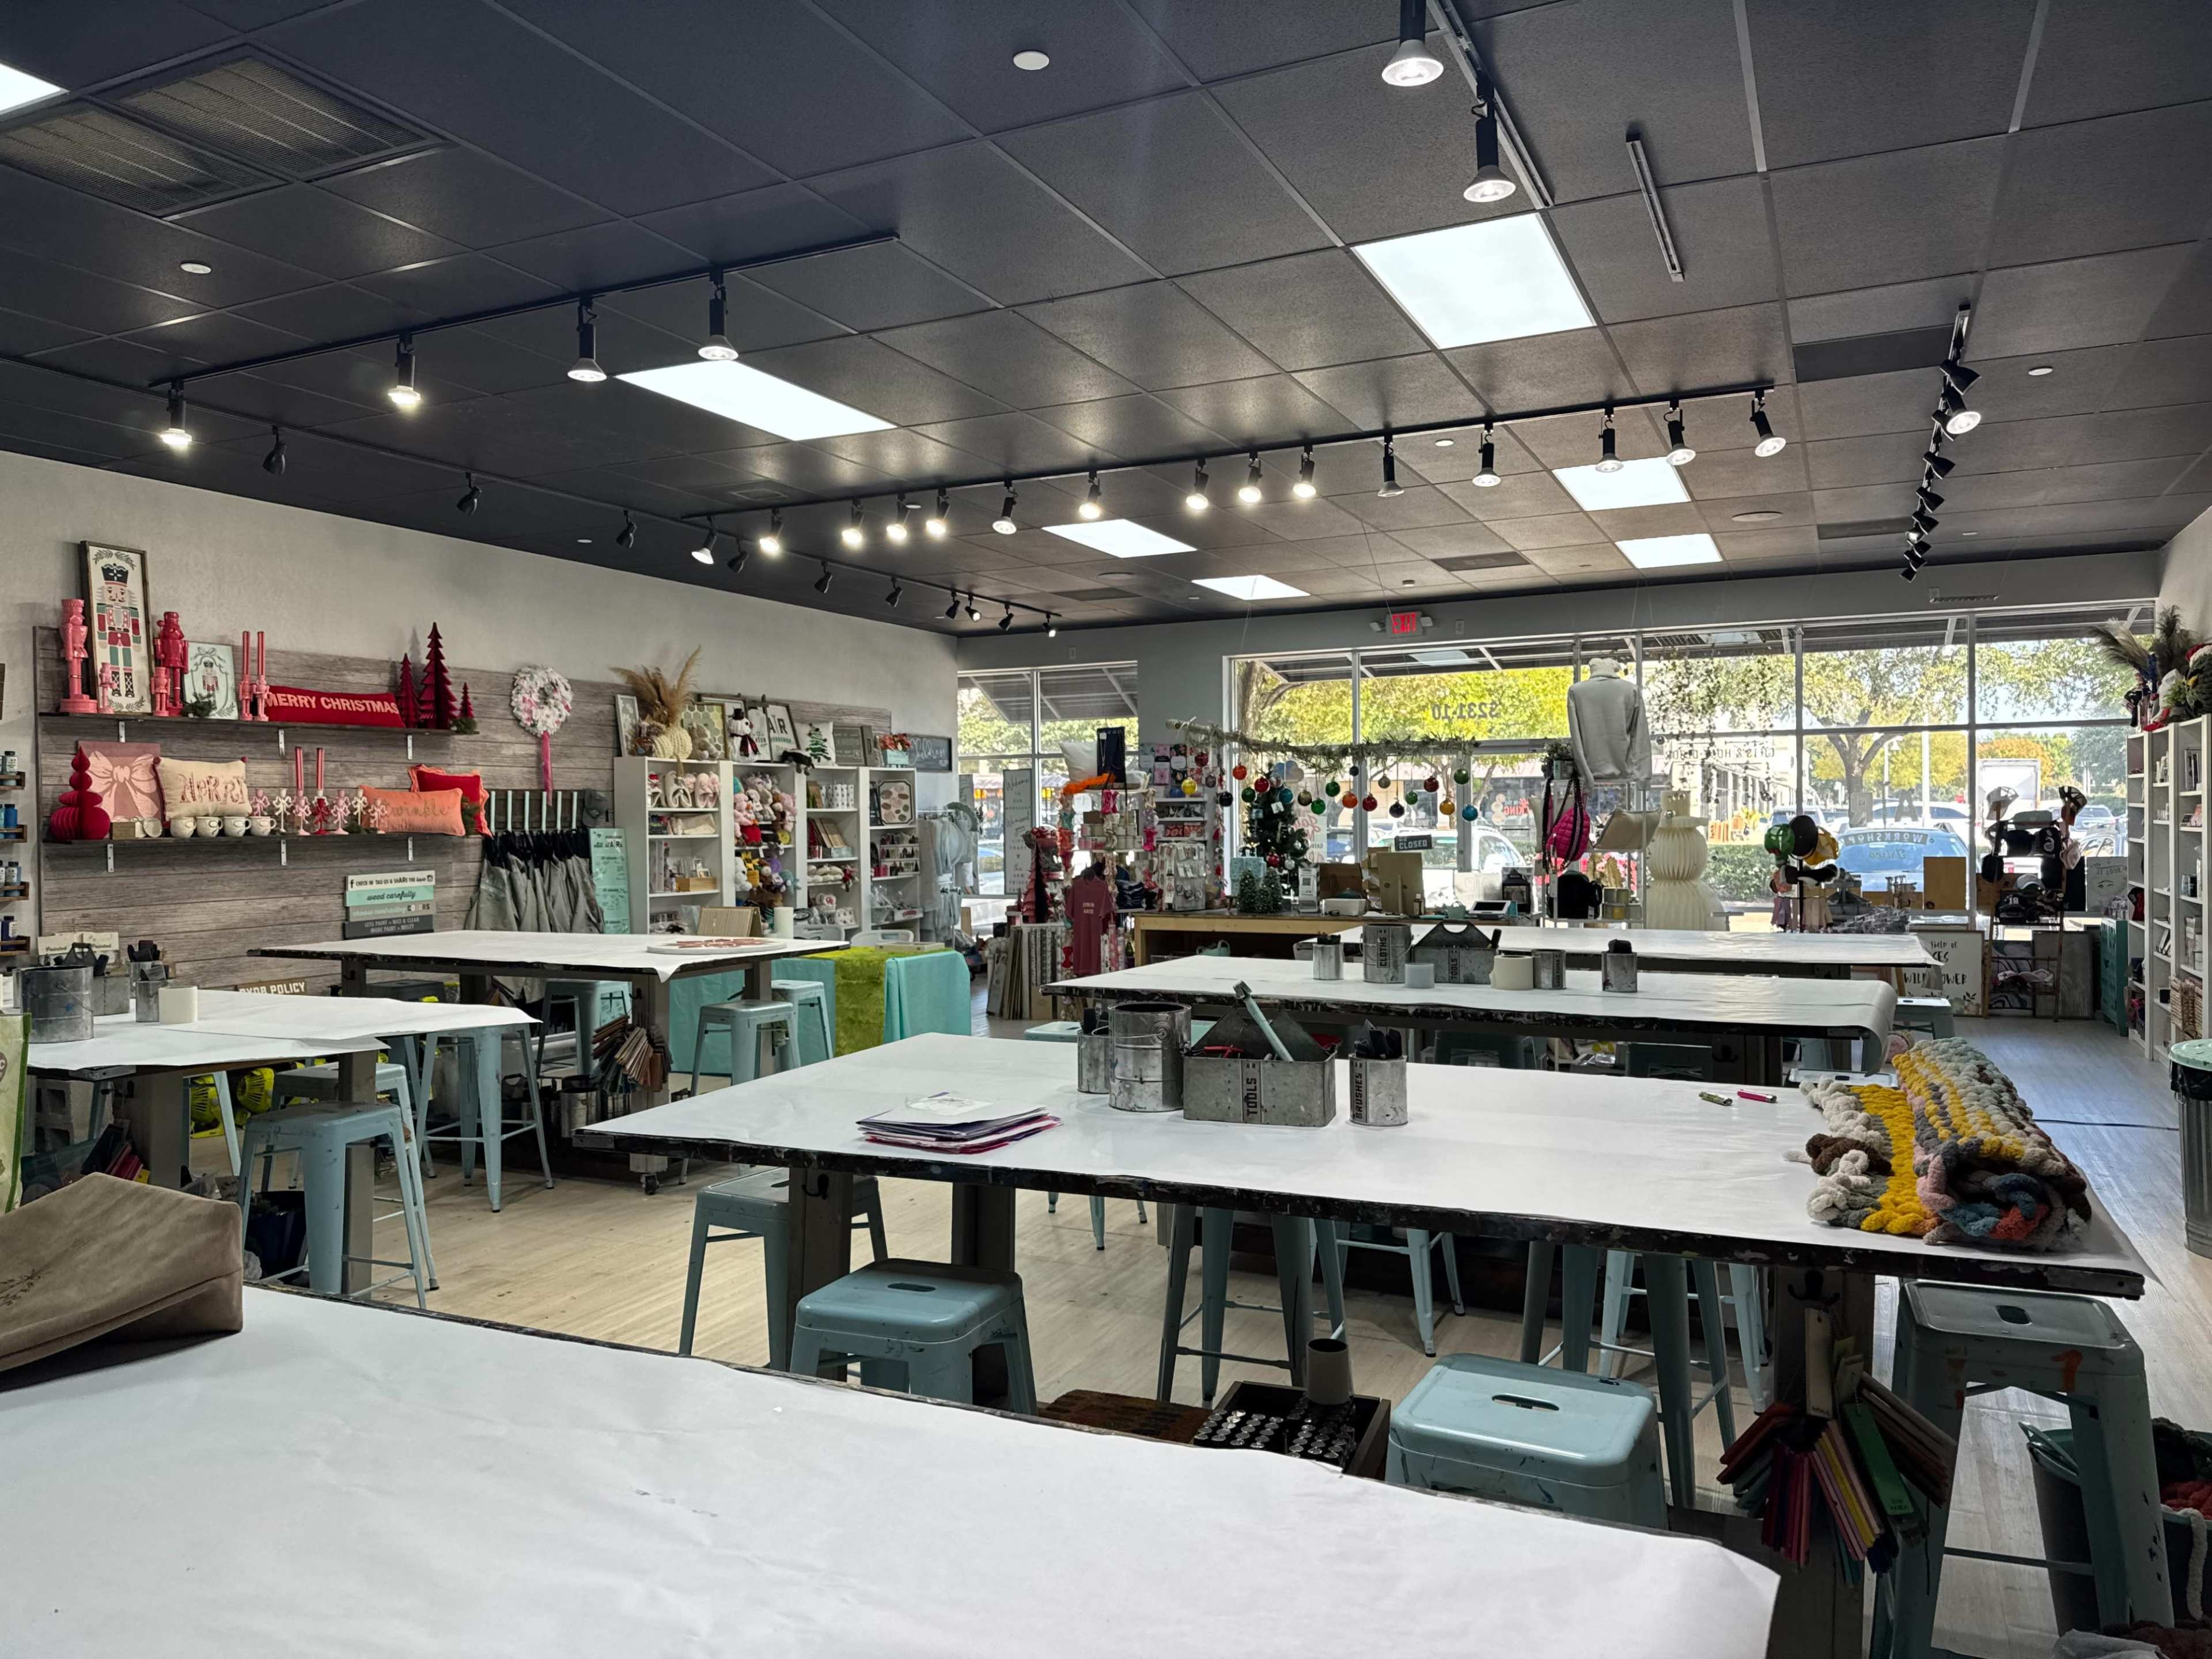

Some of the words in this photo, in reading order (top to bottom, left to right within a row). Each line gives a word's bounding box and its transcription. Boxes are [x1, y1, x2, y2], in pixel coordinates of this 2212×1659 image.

[1392, 612, 1416, 634] EXIT
[265, 693, 316, 709] MERRY
[320, 696, 399, 714] CHRISTMAS
[1399, 839, 1427, 850] CLOSED
[366, 892, 385, 900] weed
[387, 890, 416, 900] carefully
[270, 981, 305, 994] POLICY
[1246, 1078, 1258, 1116] TOOLS
[1355, 1073, 1363, 1119] BRUSHES
